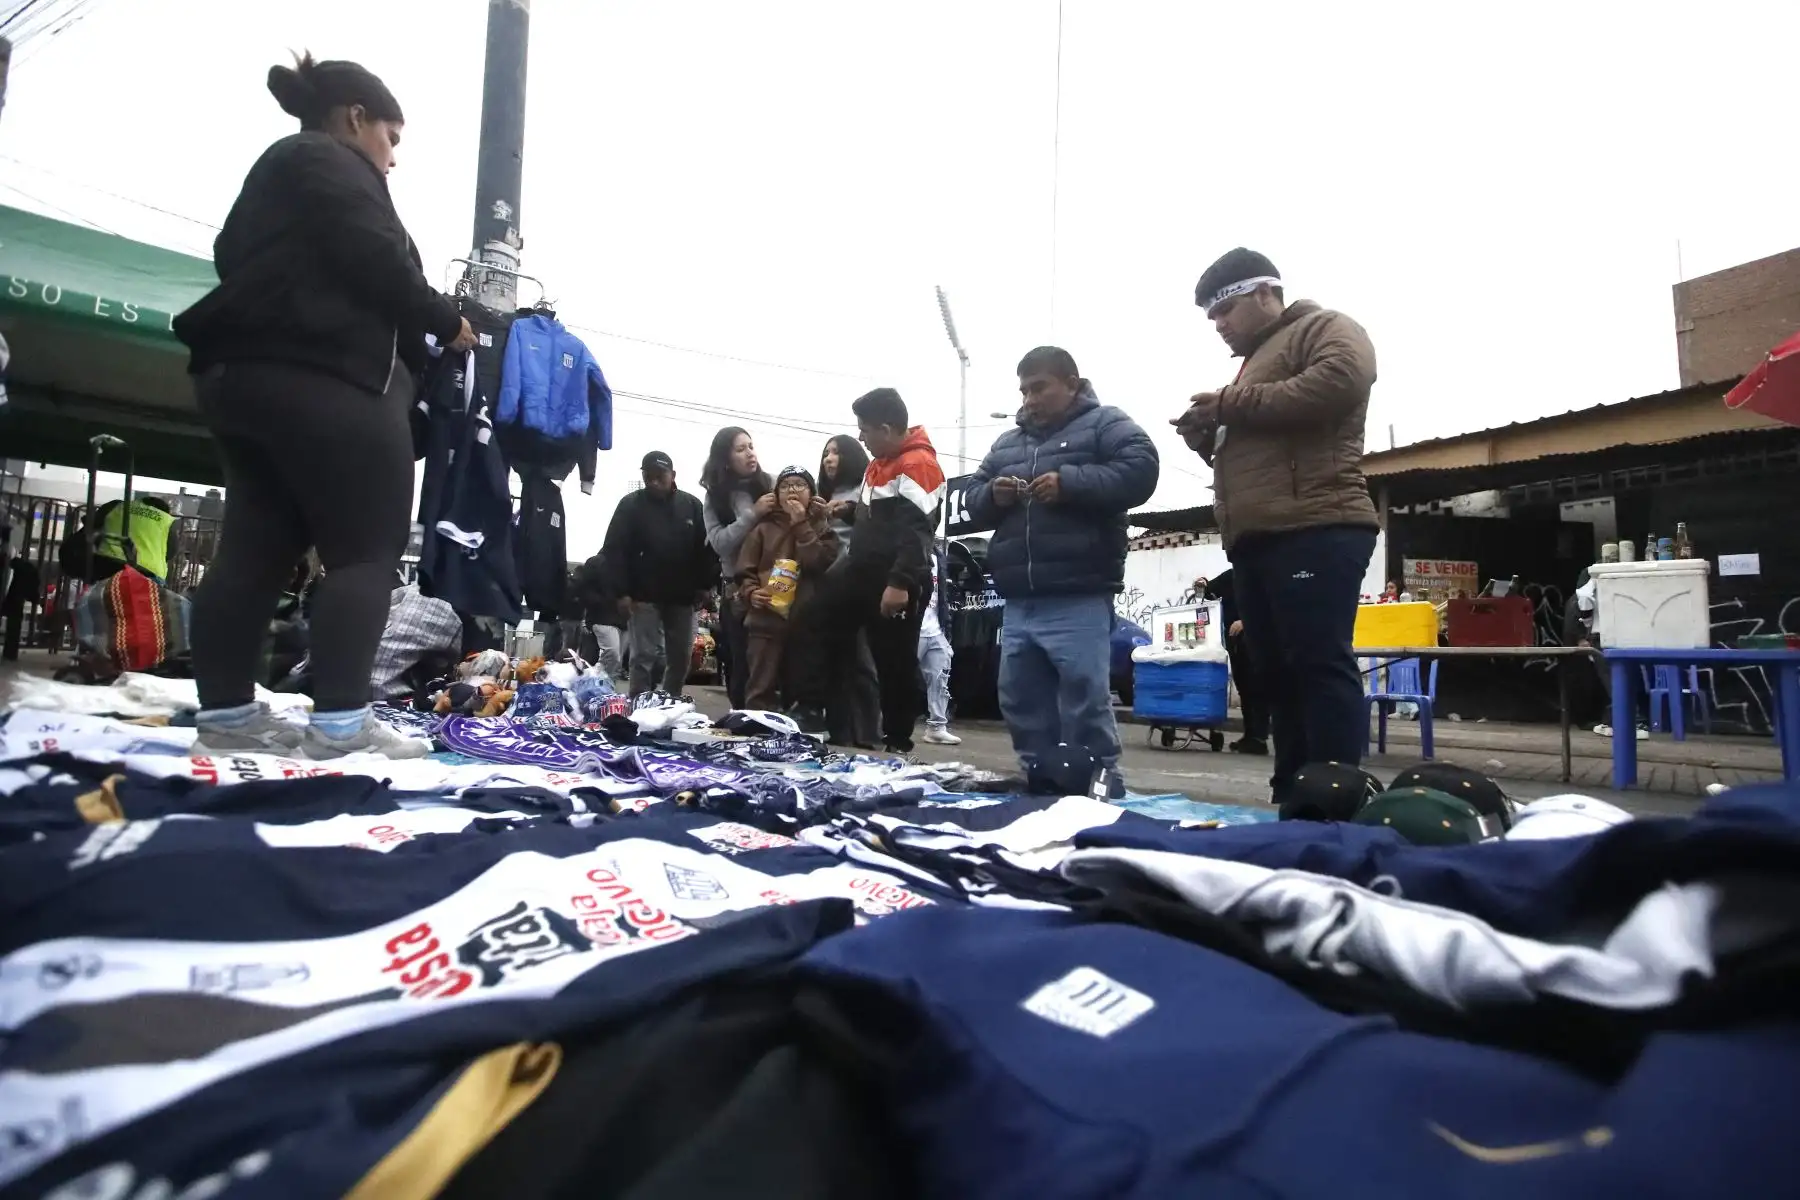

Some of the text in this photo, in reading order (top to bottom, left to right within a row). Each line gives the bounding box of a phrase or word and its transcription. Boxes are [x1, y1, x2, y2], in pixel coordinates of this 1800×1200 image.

[94, 296, 139, 323] ES
[1415, 561, 1478, 575] SE VENDE
